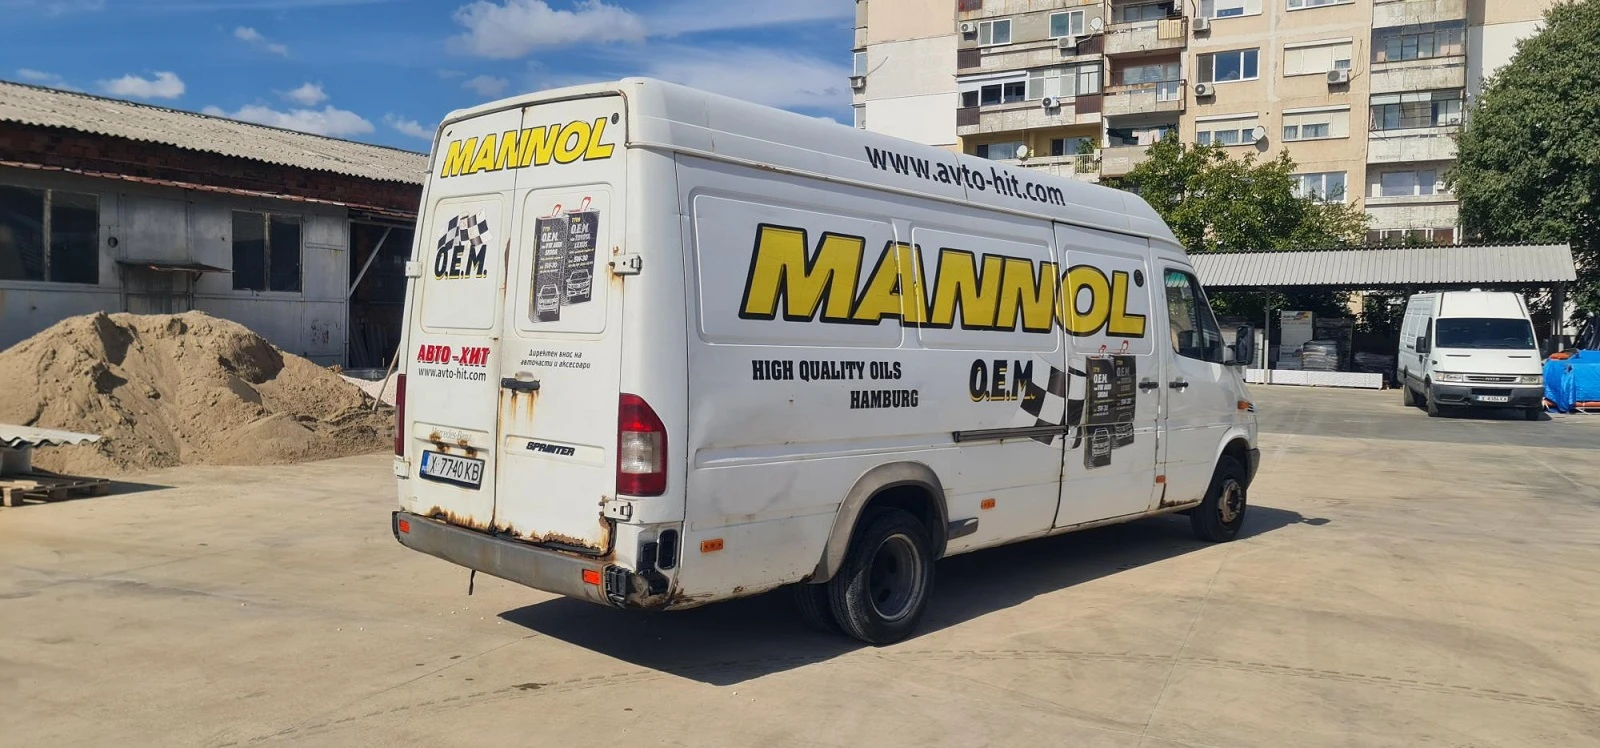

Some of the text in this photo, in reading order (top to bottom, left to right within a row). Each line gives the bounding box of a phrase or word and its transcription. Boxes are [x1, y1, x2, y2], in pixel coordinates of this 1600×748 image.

[441, 117, 615, 178] MANNOL
[865, 146, 1066, 206] www.avto-hit.com
[434, 246, 488, 280] O.E.M.
[739, 222, 1147, 338] MANNOL
[520, 359, 553, 367] авточасти
[558, 361, 591, 370] аксесоари
[529, 349, 558, 358] Директен
[559, 351, 573, 359] внос
[418, 368, 487, 382] www.avto-hit.com
[752, 360, 902, 382] HIGH QUALITY OILS
[969, 359, 1036, 403] O.E.M.
[850, 389, 919, 409] HAMBURG
[526, 441, 576, 456] SPRINTER
[429, 456, 480, 481] X 7740 KB
